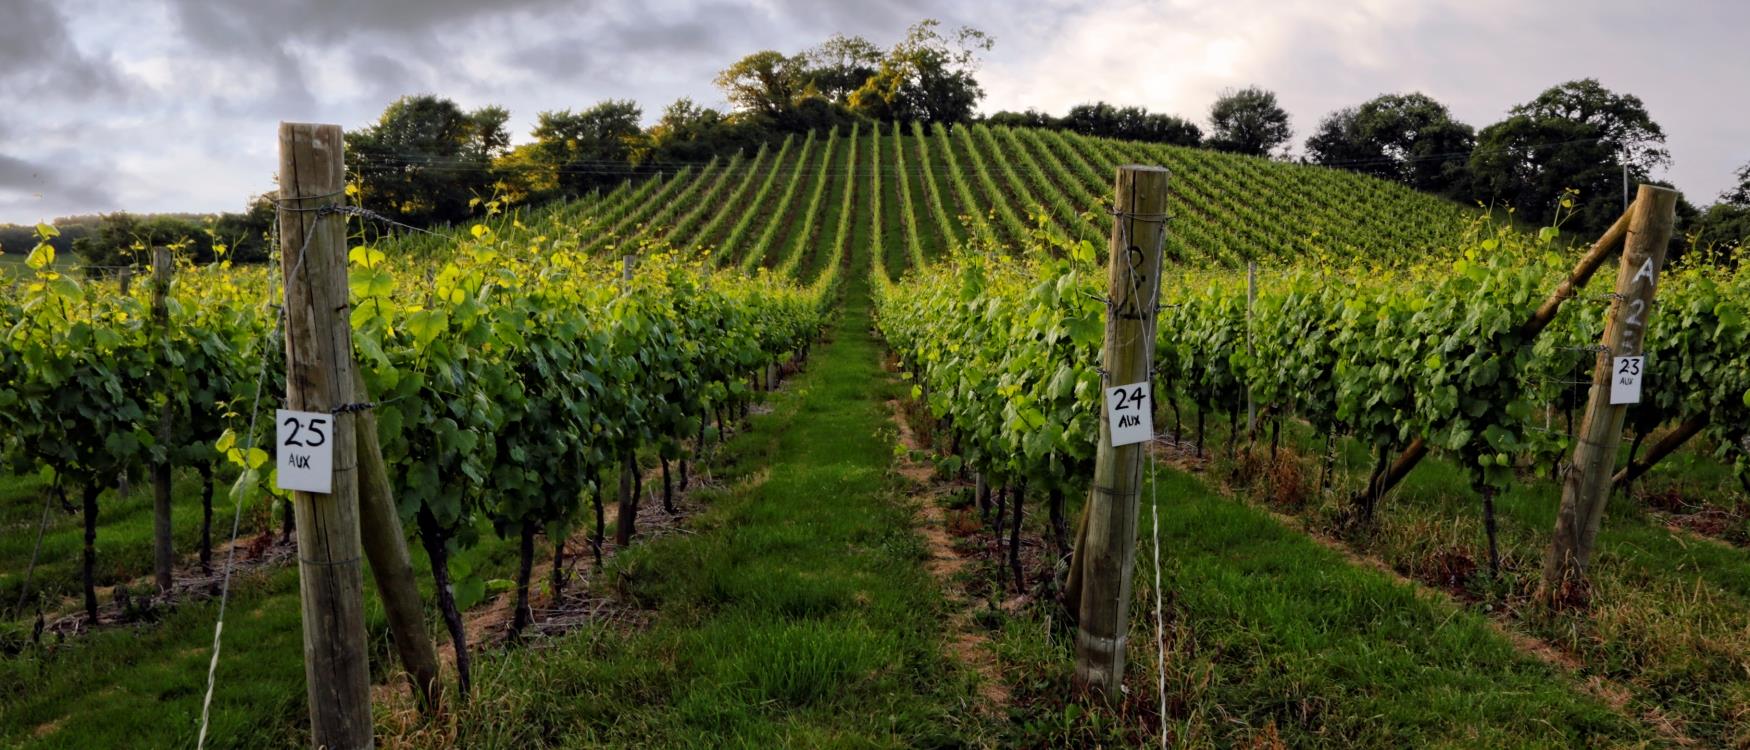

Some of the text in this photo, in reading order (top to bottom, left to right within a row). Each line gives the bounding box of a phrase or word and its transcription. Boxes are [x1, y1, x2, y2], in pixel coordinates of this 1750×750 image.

[1618, 358, 1640, 376] 23
[1113, 386, 1146, 411] 24
[1118, 414, 1141, 428] AUX
[284, 417, 326, 447] 25
[288, 452, 311, 470] AUX
